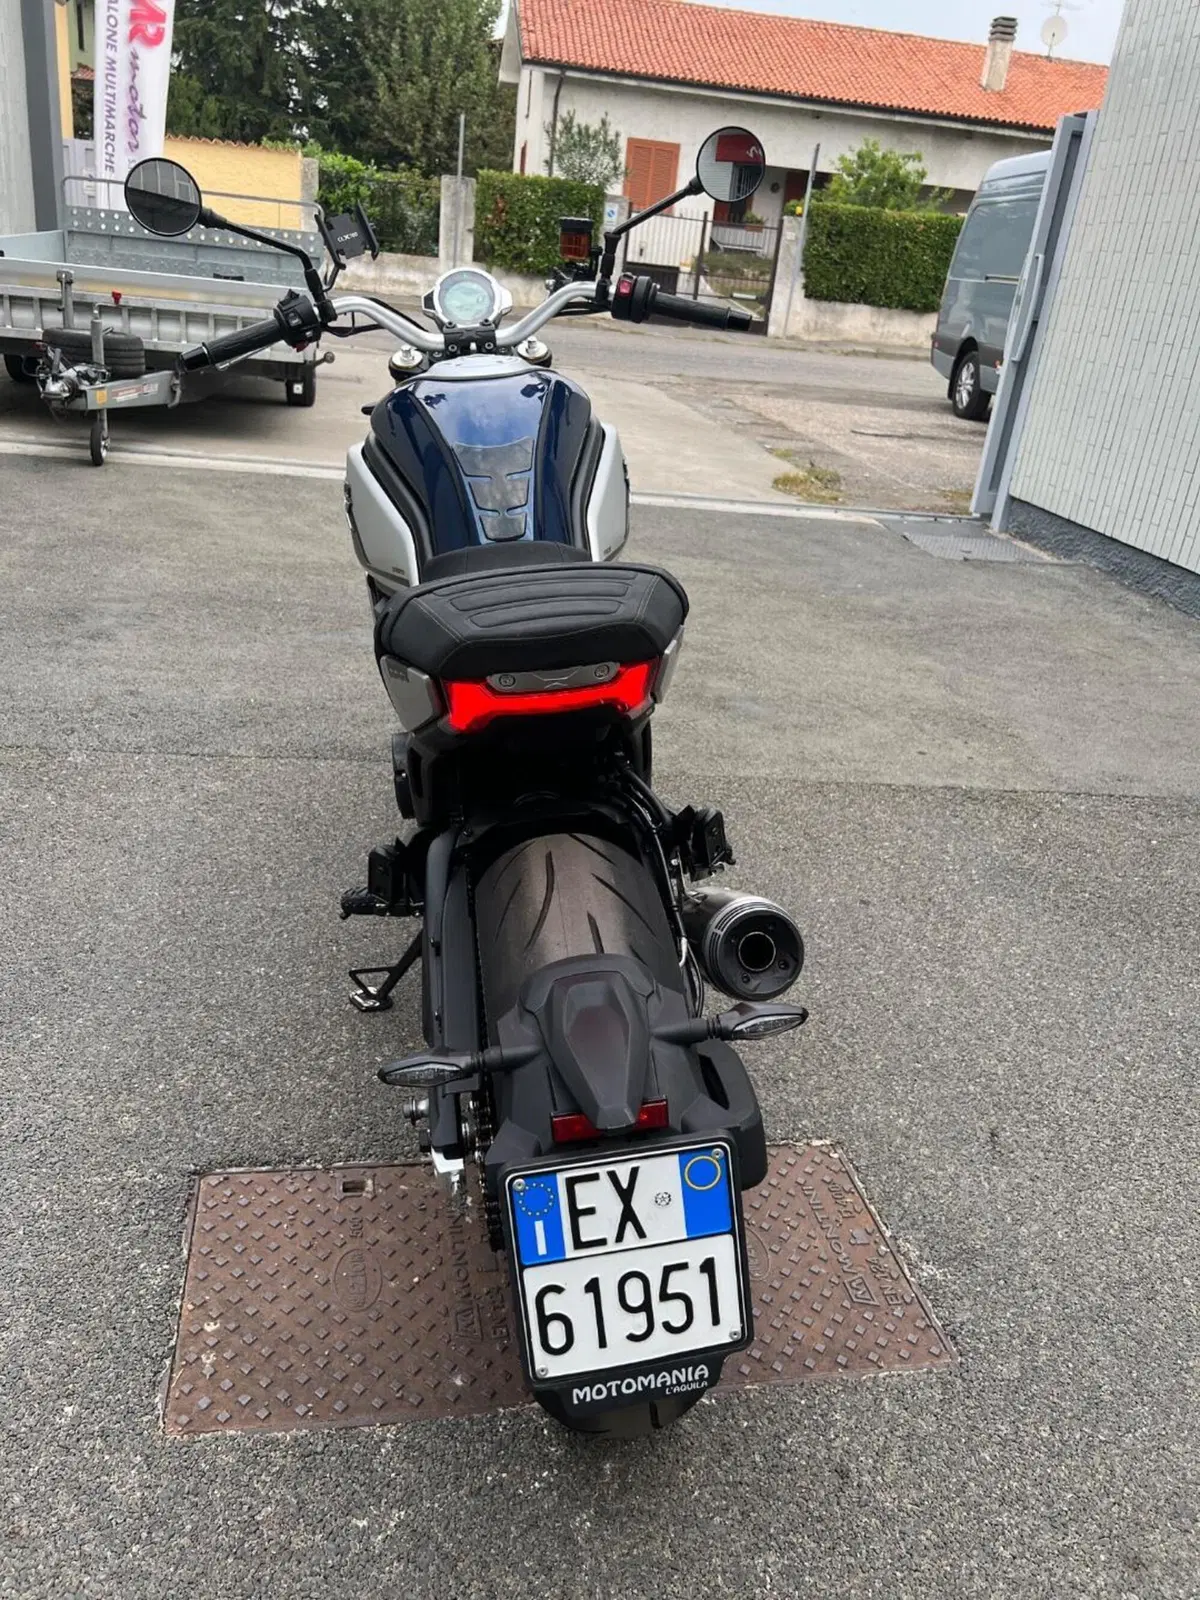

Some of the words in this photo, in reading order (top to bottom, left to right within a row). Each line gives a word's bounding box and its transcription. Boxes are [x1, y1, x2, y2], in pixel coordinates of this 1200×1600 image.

[104, 55, 118, 174] MULTIMARCHE
[128, 47, 147, 153] motor
[565, 1166, 647, 1250] EX
[802, 1185, 859, 1275] MONTINI
[535, 1257, 720, 1356] 61951
[572, 1364, 709, 1405] MOTOMANIA
[665, 1380, 708, 1395] L'AQUILA
